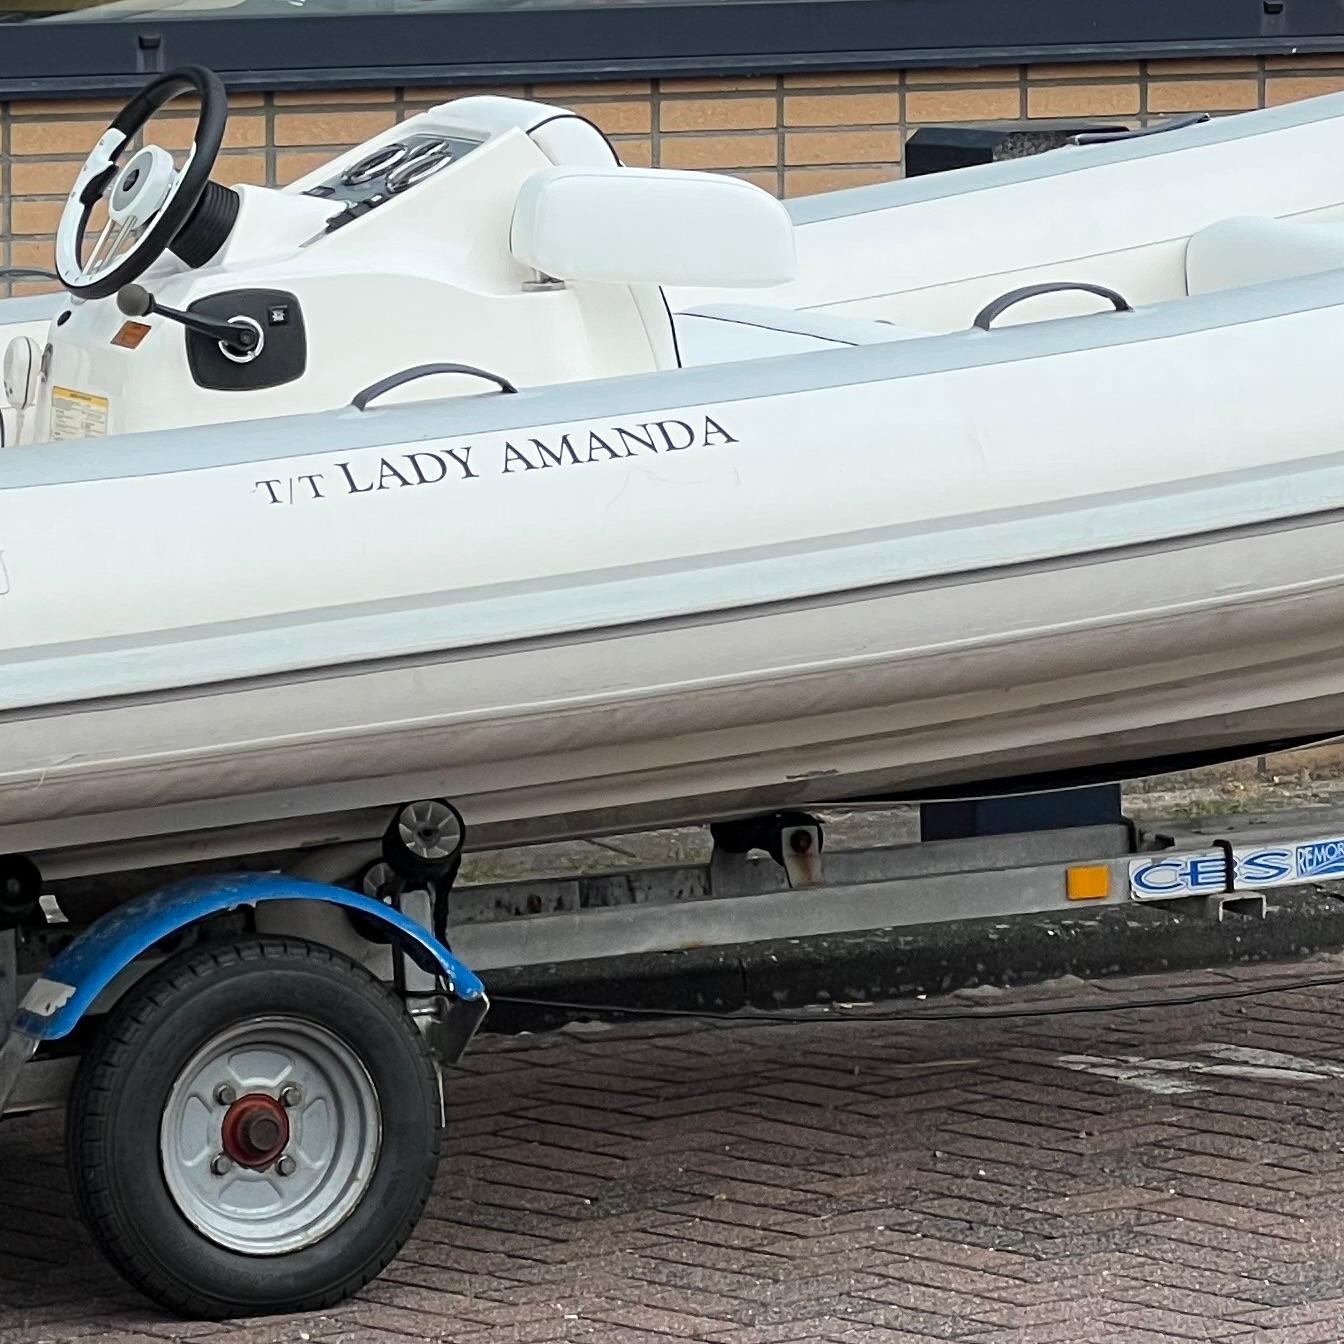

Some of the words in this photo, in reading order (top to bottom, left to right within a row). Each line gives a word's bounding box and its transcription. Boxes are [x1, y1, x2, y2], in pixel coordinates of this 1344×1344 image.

[255, 473, 324, 504] T/T
[335, 445, 479, 494] LADY
[501, 415, 738, 473] AMANDA
